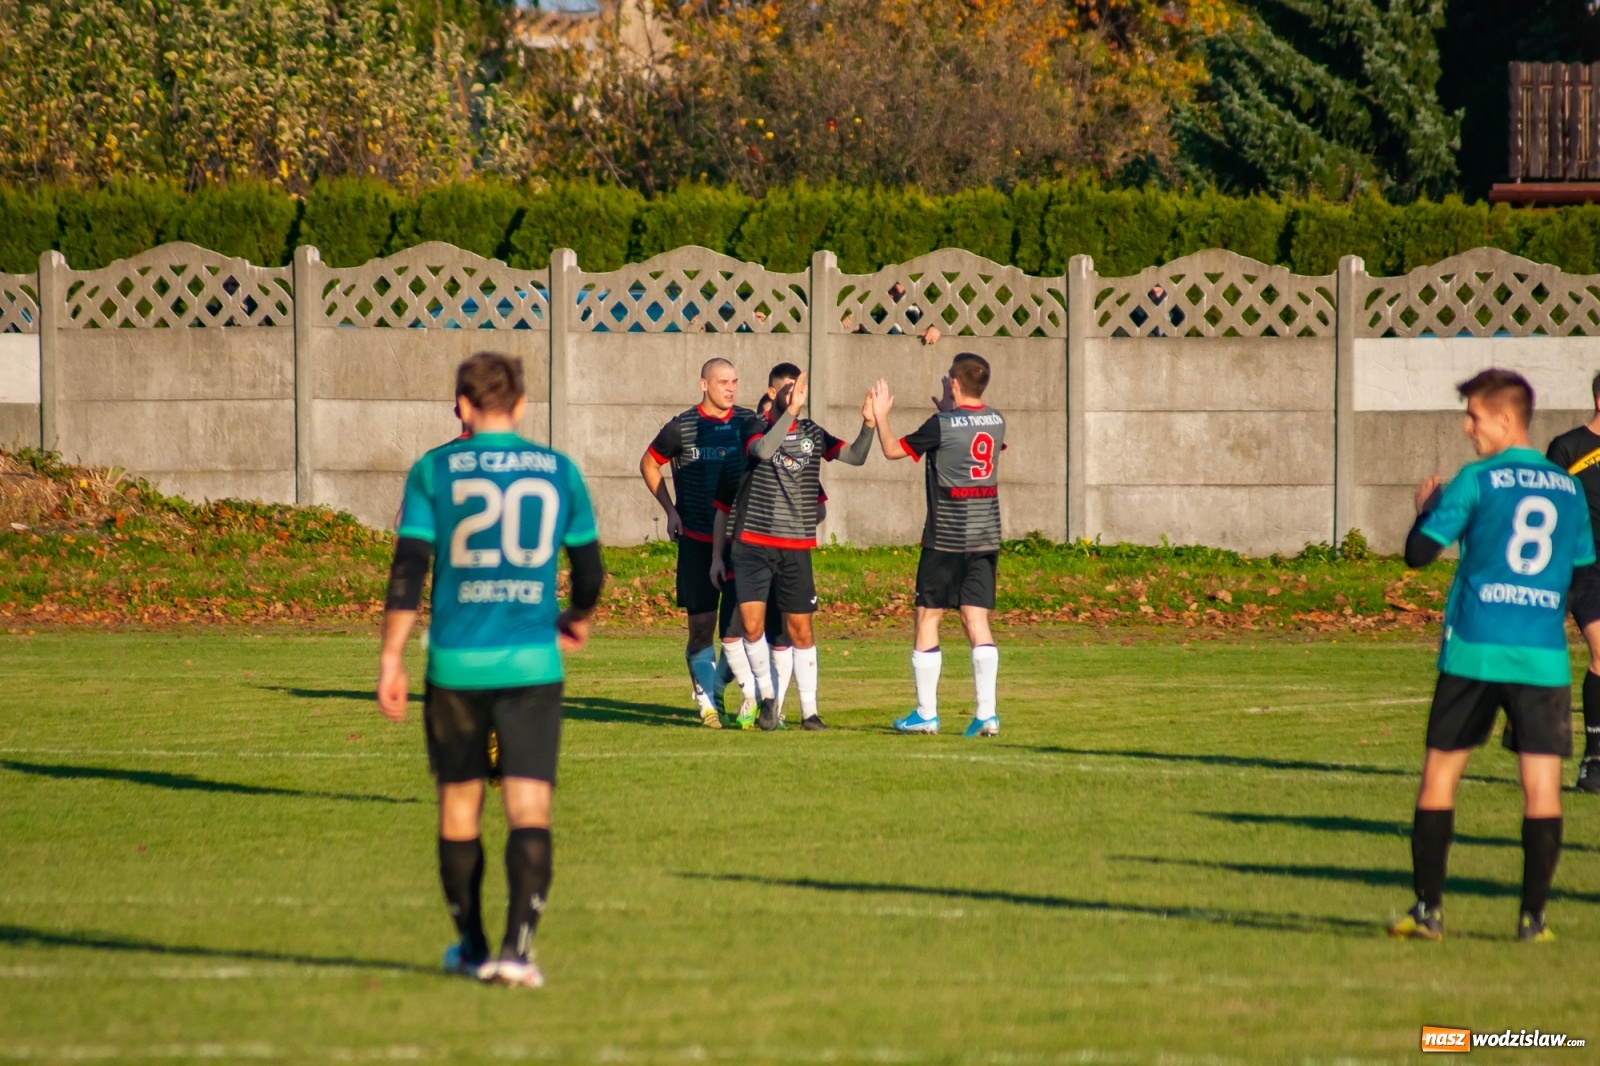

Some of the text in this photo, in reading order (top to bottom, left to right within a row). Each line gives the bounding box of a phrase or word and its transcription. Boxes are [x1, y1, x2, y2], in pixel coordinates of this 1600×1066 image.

[950, 416, 968, 427] LKS
[449, 452, 477, 472] KS
[970, 432, 994, 480] 9
[1489, 468, 1576, 495] KS CZARNI
[451, 478, 559, 568] 20
[1506, 495, 1558, 576] 8
